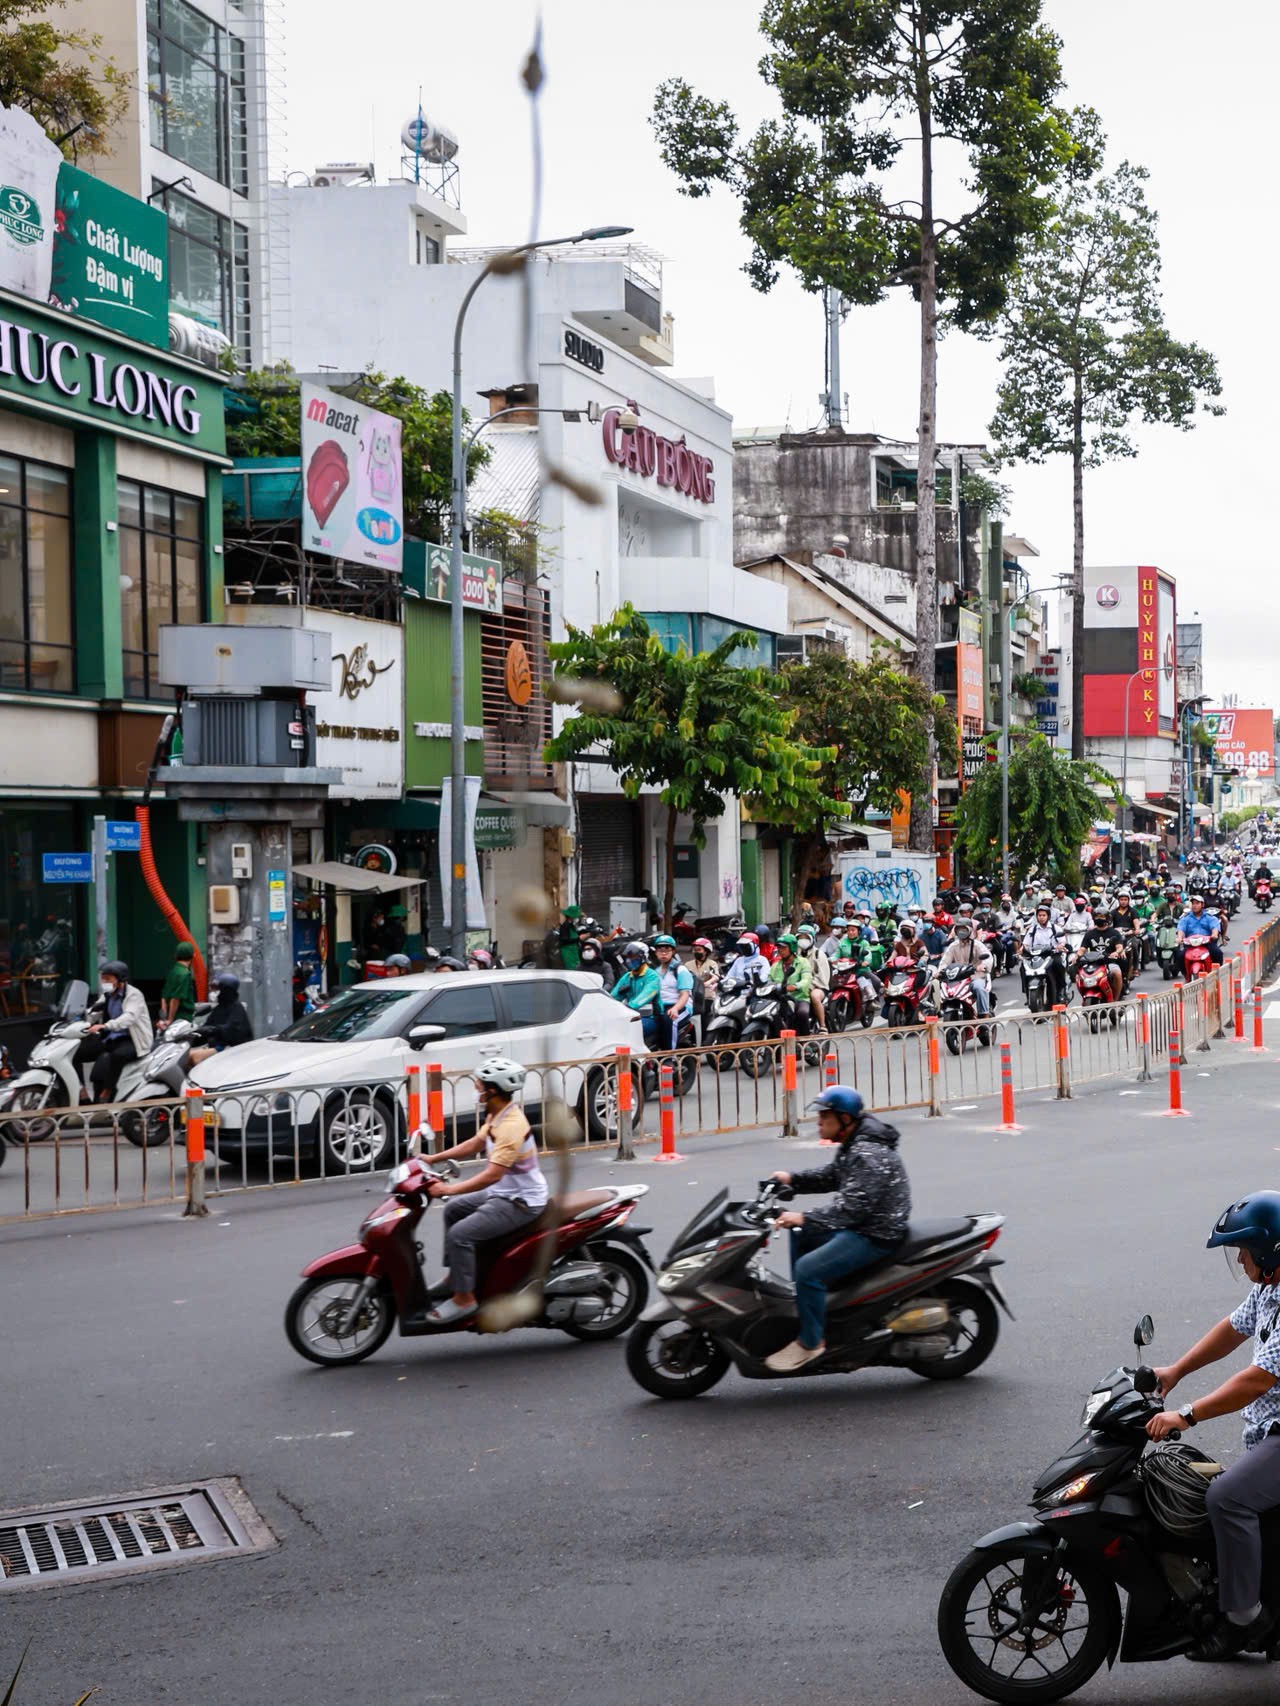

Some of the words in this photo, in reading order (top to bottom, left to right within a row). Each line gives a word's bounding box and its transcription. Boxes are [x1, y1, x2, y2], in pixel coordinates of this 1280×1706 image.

[21, 222, 43, 239] LONG
[86, 219, 120, 258] Chất
[123, 236, 162, 282] Lượng
[86, 256, 119, 293] Đậm
[121, 275, 134, 306] vị
[565, 330, 605, 371] STUDIO
[91, 352, 201, 435] LONG
[306, 398, 360, 436] macat
[1101, 587, 1115, 601] K
[475, 816, 499, 830] COFFEE
